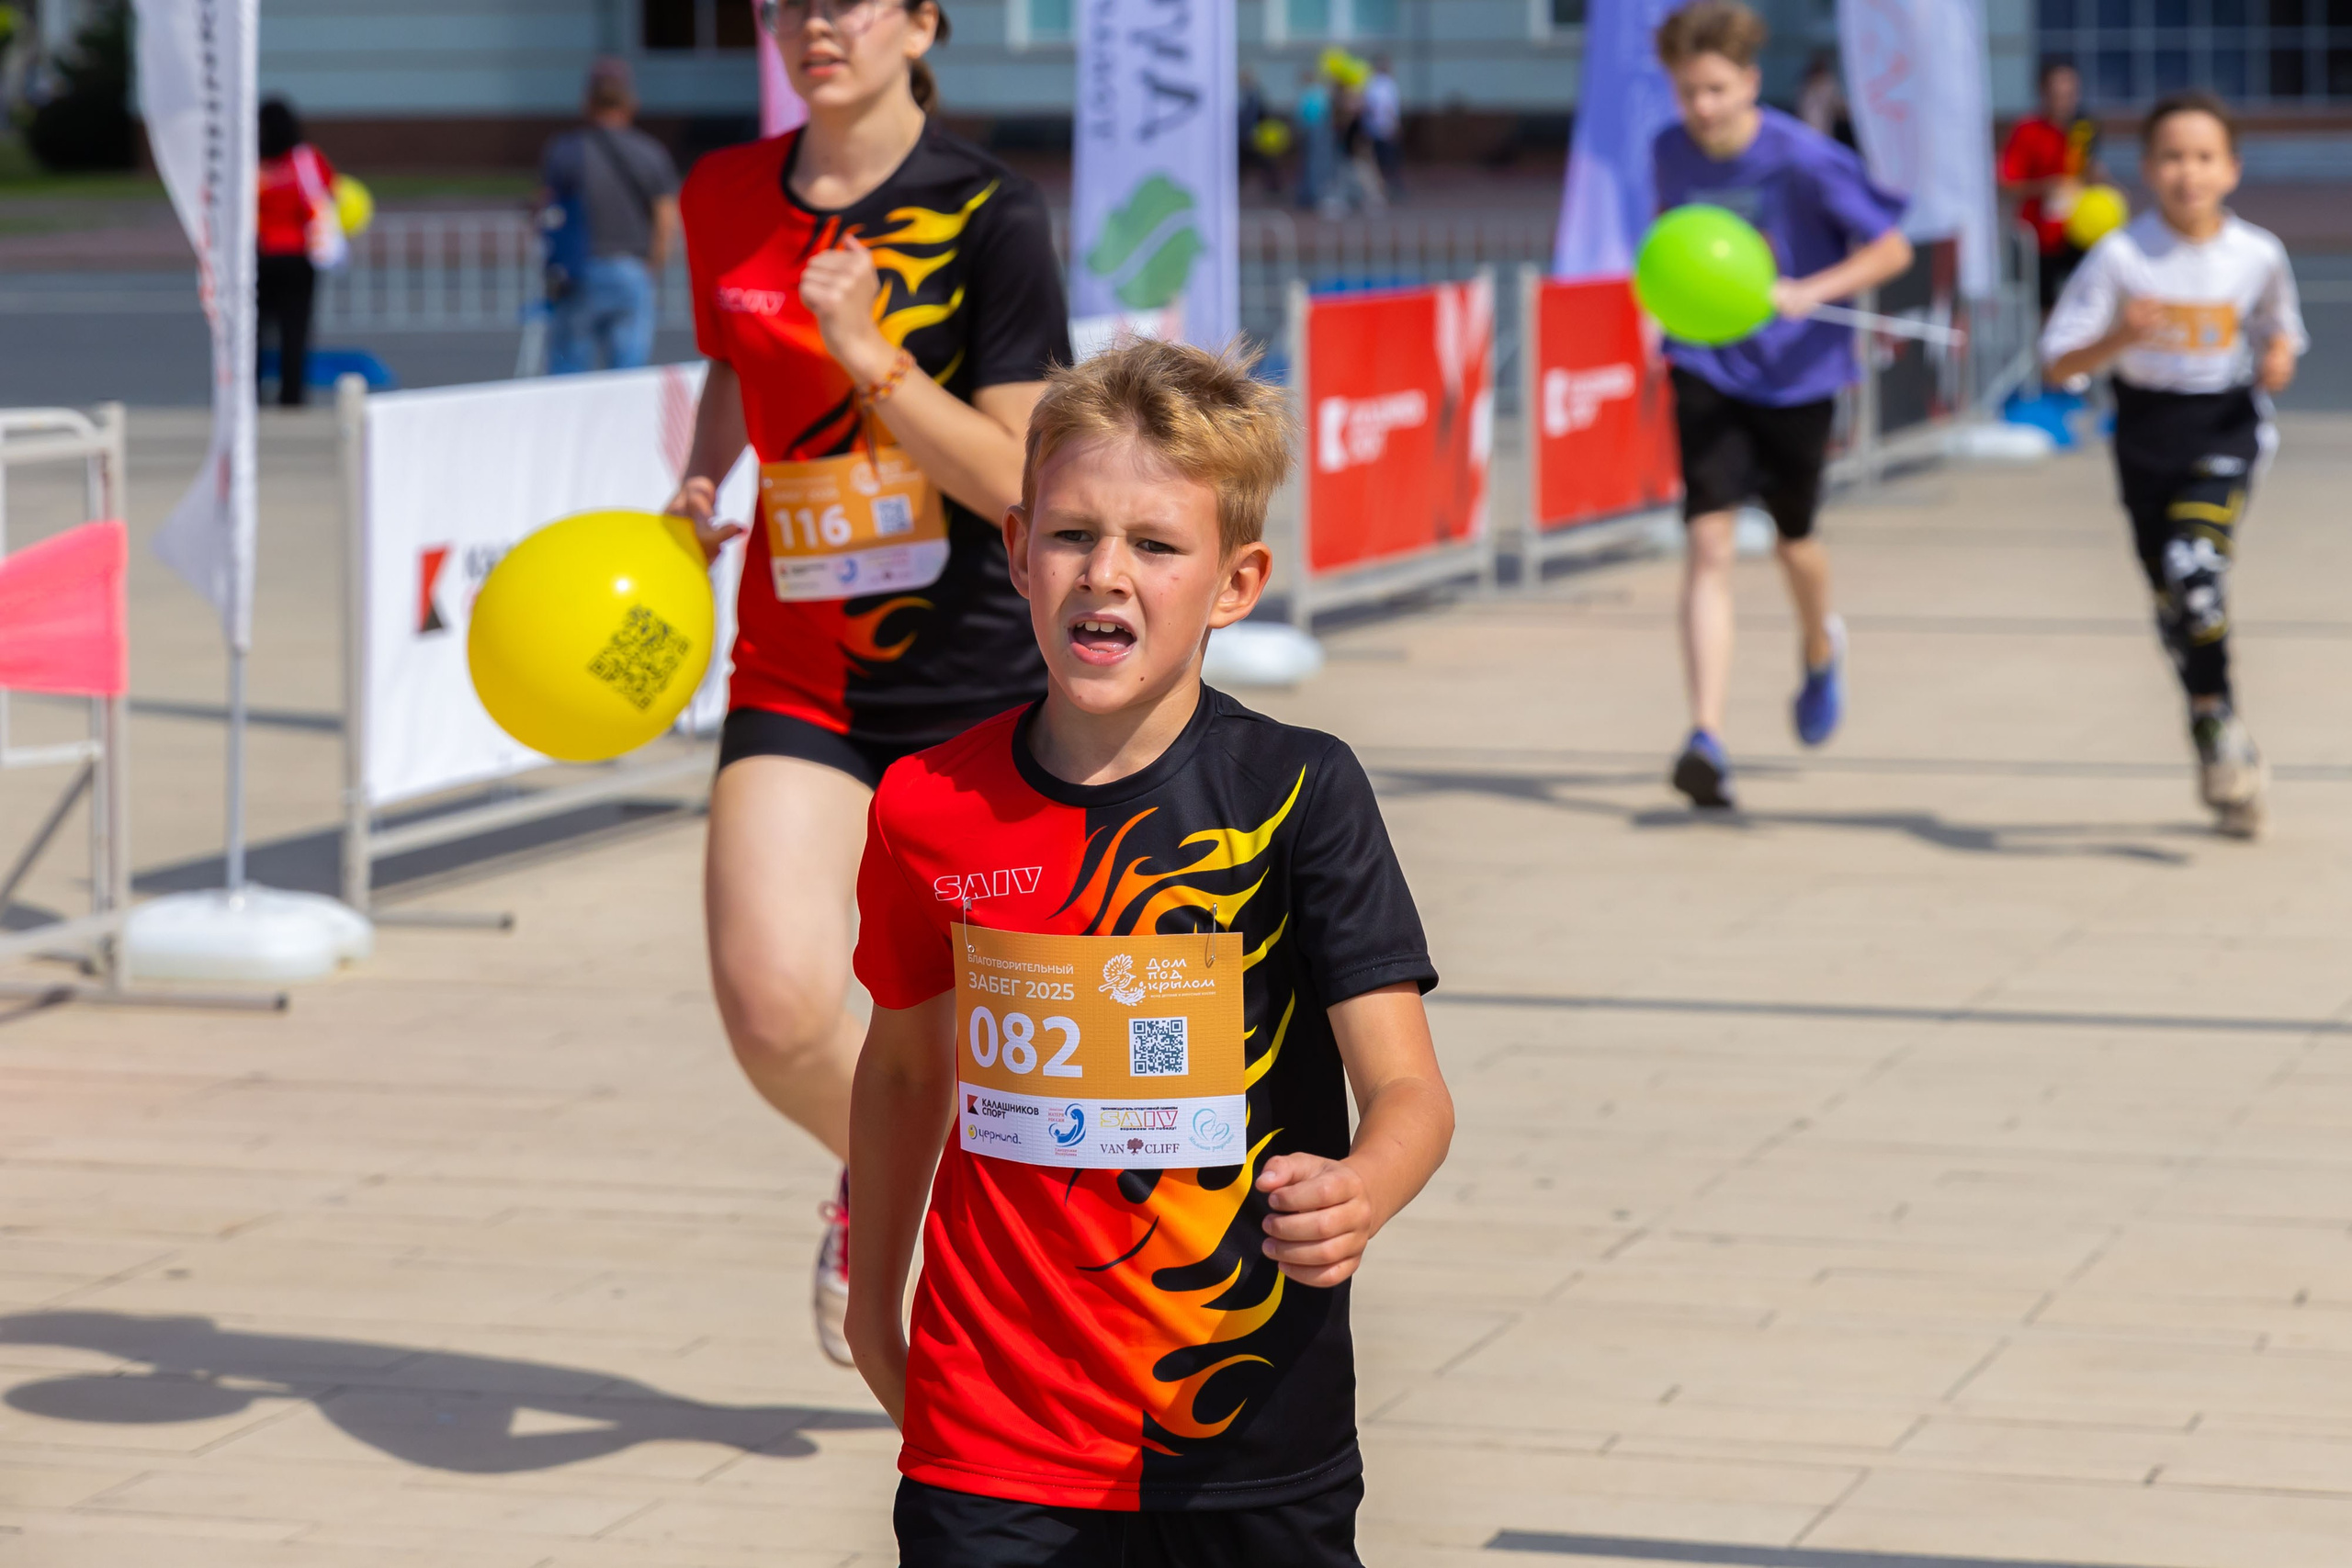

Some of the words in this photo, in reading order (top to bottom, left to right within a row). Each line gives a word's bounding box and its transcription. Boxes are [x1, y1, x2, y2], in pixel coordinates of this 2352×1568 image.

[774, 503, 852, 549] 116
[933, 865, 1043, 902] SAIV
[967, 953, 1074, 975] БЛАГОТВОРИТЕЛЬНЫЙ
[968, 971, 1021, 997] ЗАБЕГ
[1025, 980, 1075, 1001] 2025
[969, 1005, 1083, 1078] 082
[981, 1097, 1040, 1116] КАЛАШНИКОВ
[981, 1107, 1006, 1120] СПОРТ
[1100, 1110, 1179, 1128] SAIV
[1100, 1144, 1125, 1155] VAN
[1145, 1143, 1181, 1155] CLIFF
